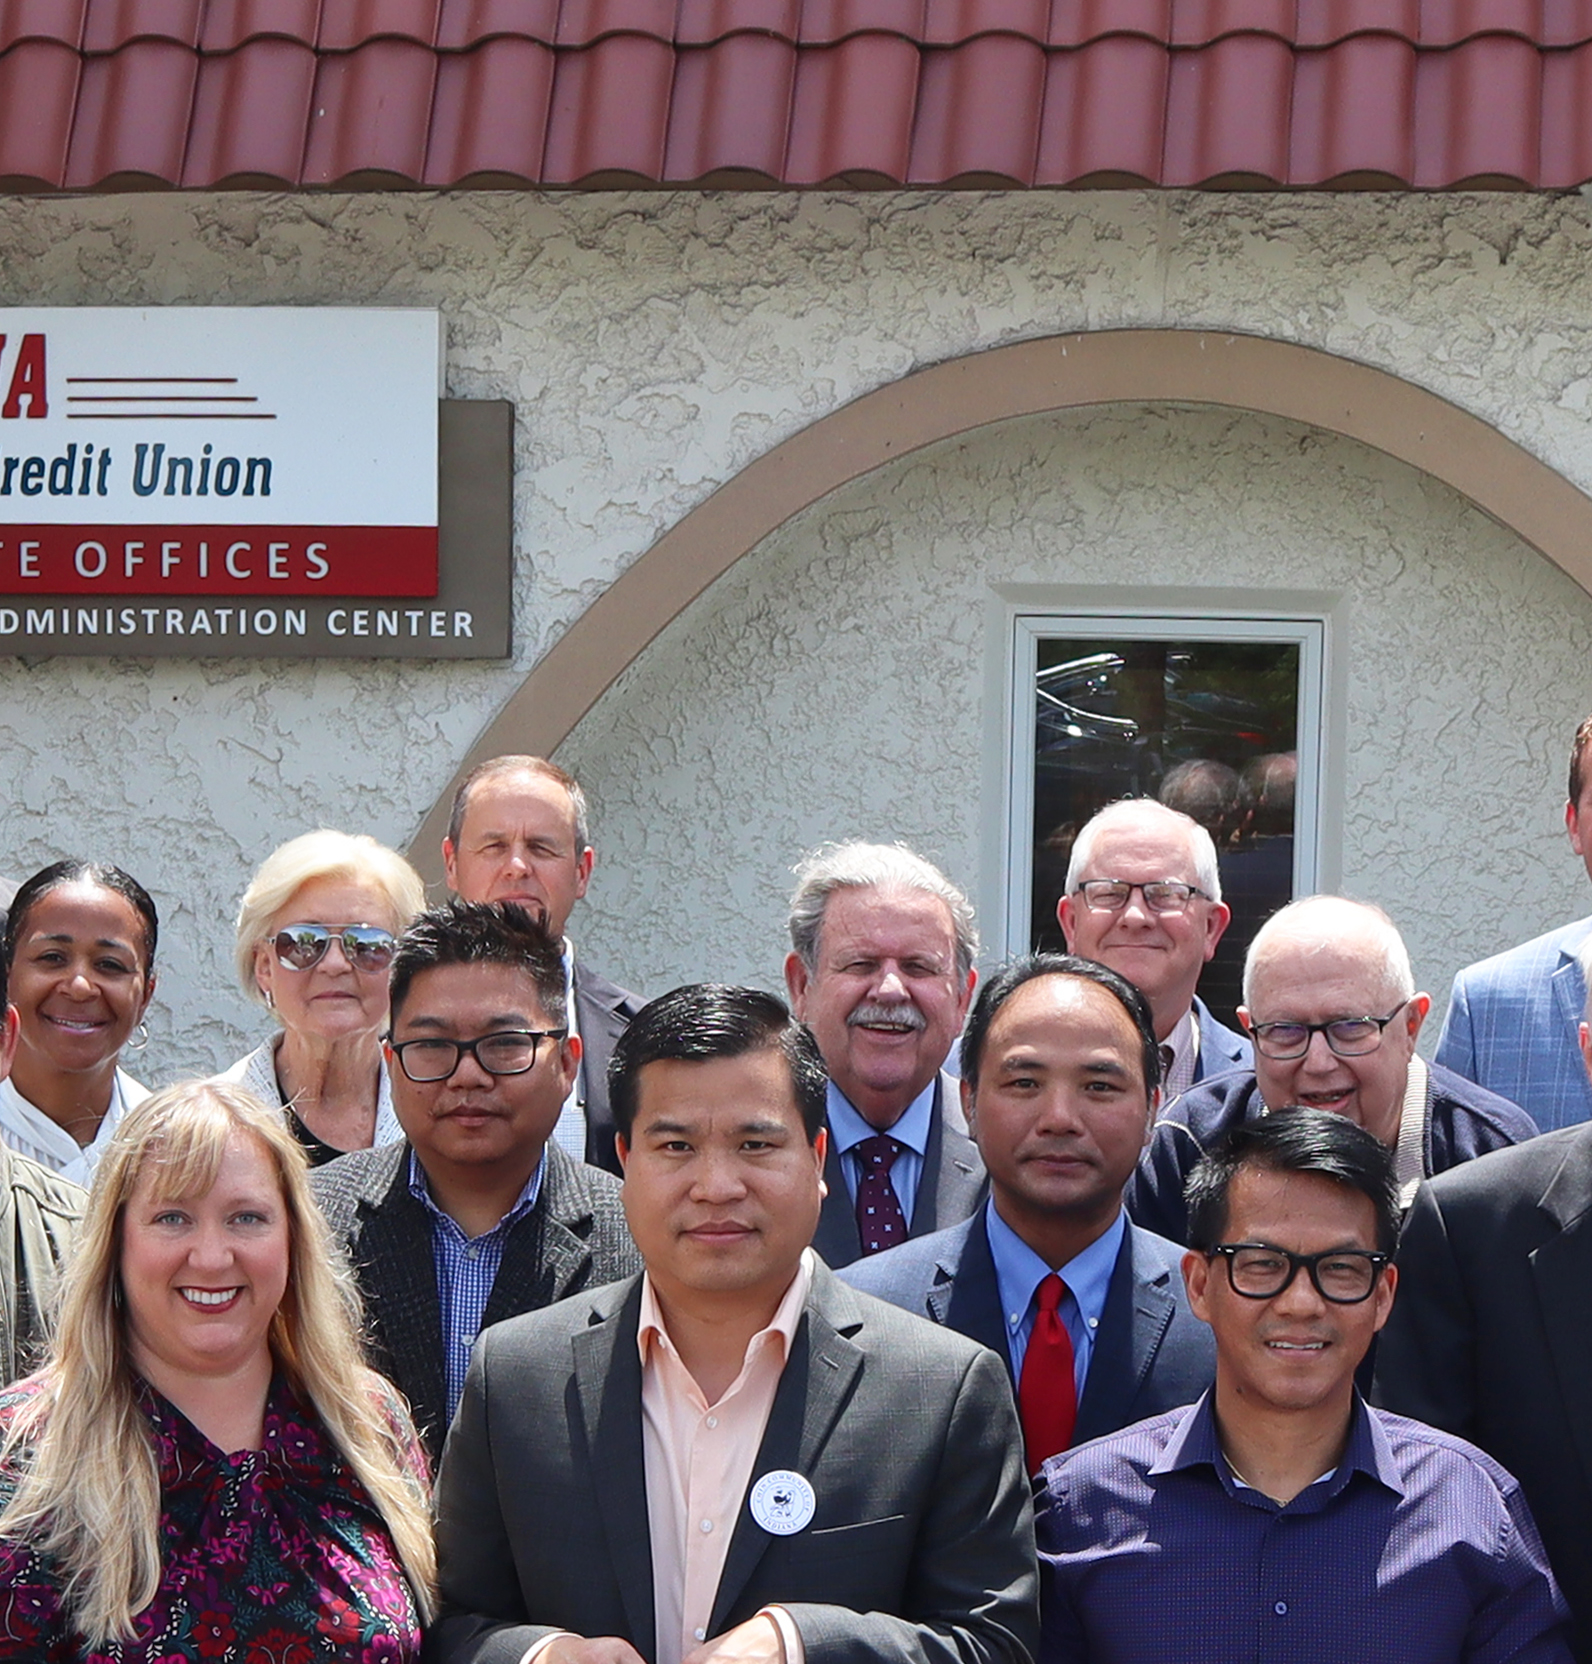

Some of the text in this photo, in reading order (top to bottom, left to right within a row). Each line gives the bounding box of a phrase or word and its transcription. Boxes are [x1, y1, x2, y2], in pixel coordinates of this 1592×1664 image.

[133, 443, 273, 497] Union
[75, 541, 331, 580] OFFICES
[327, 609, 474, 638] CENTER
